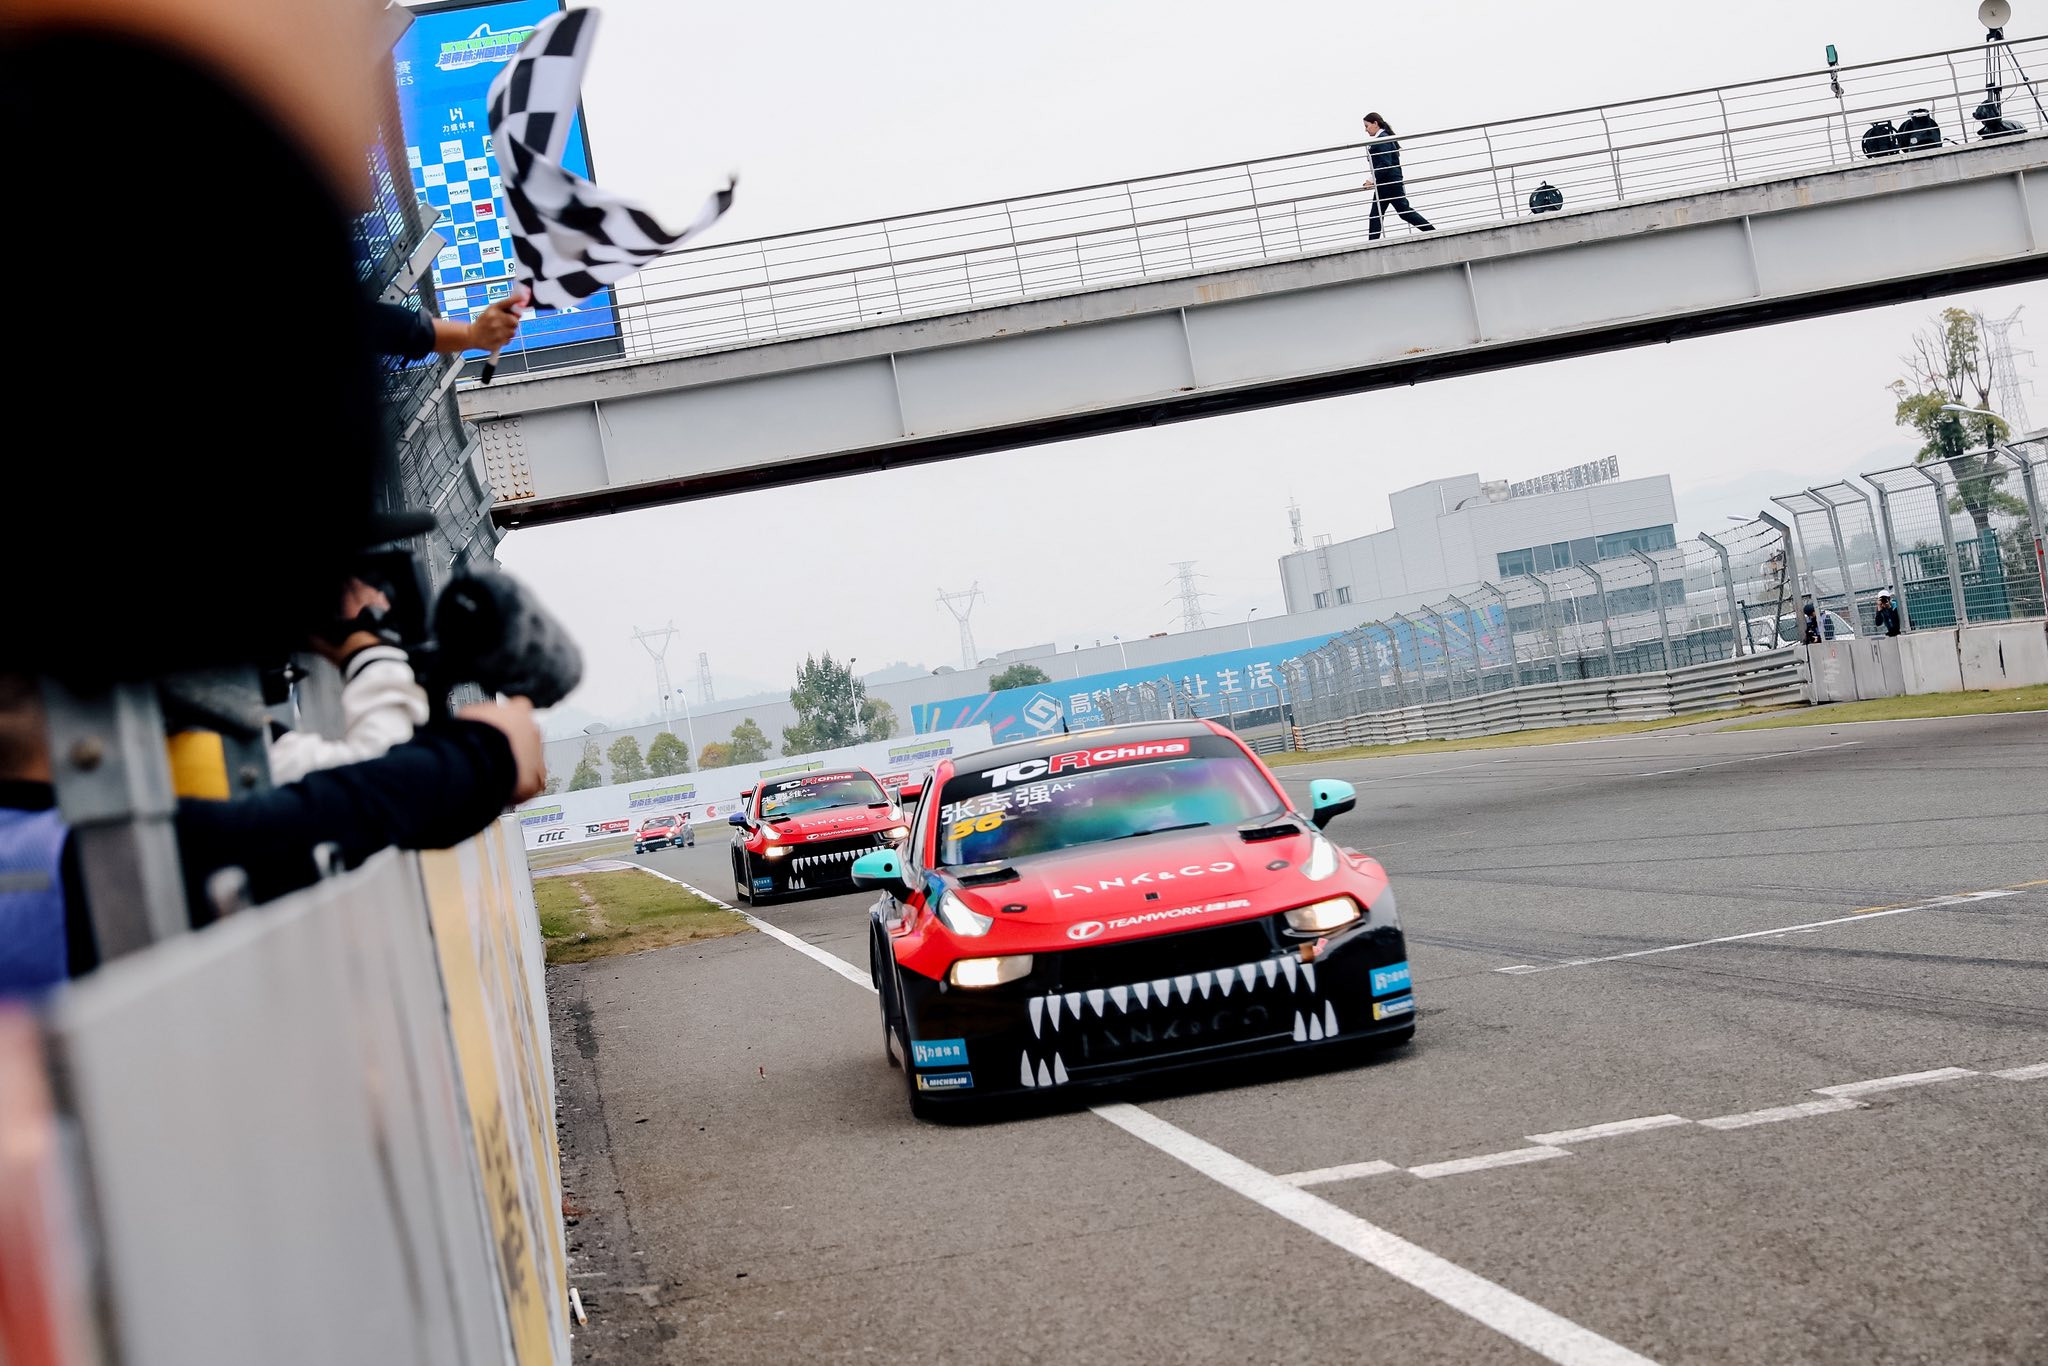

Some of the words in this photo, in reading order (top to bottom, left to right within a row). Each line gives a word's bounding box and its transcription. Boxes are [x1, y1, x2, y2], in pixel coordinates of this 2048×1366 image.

[443, 121, 475, 133] 力盛体育
[981, 749, 1091, 788] TCR
[1092, 742, 1185, 762] China
[941, 783, 1052, 826] 张志强
[1052, 781, 1076, 794] A+
[538, 830, 566, 843] CTCC
[947, 811, 1004, 841] 36
[1053, 861, 1235, 899] LYNK&CO
[1107, 904, 1203, 929] TEAMWORK
[929, 1077, 967, 1087] MICHELIN
